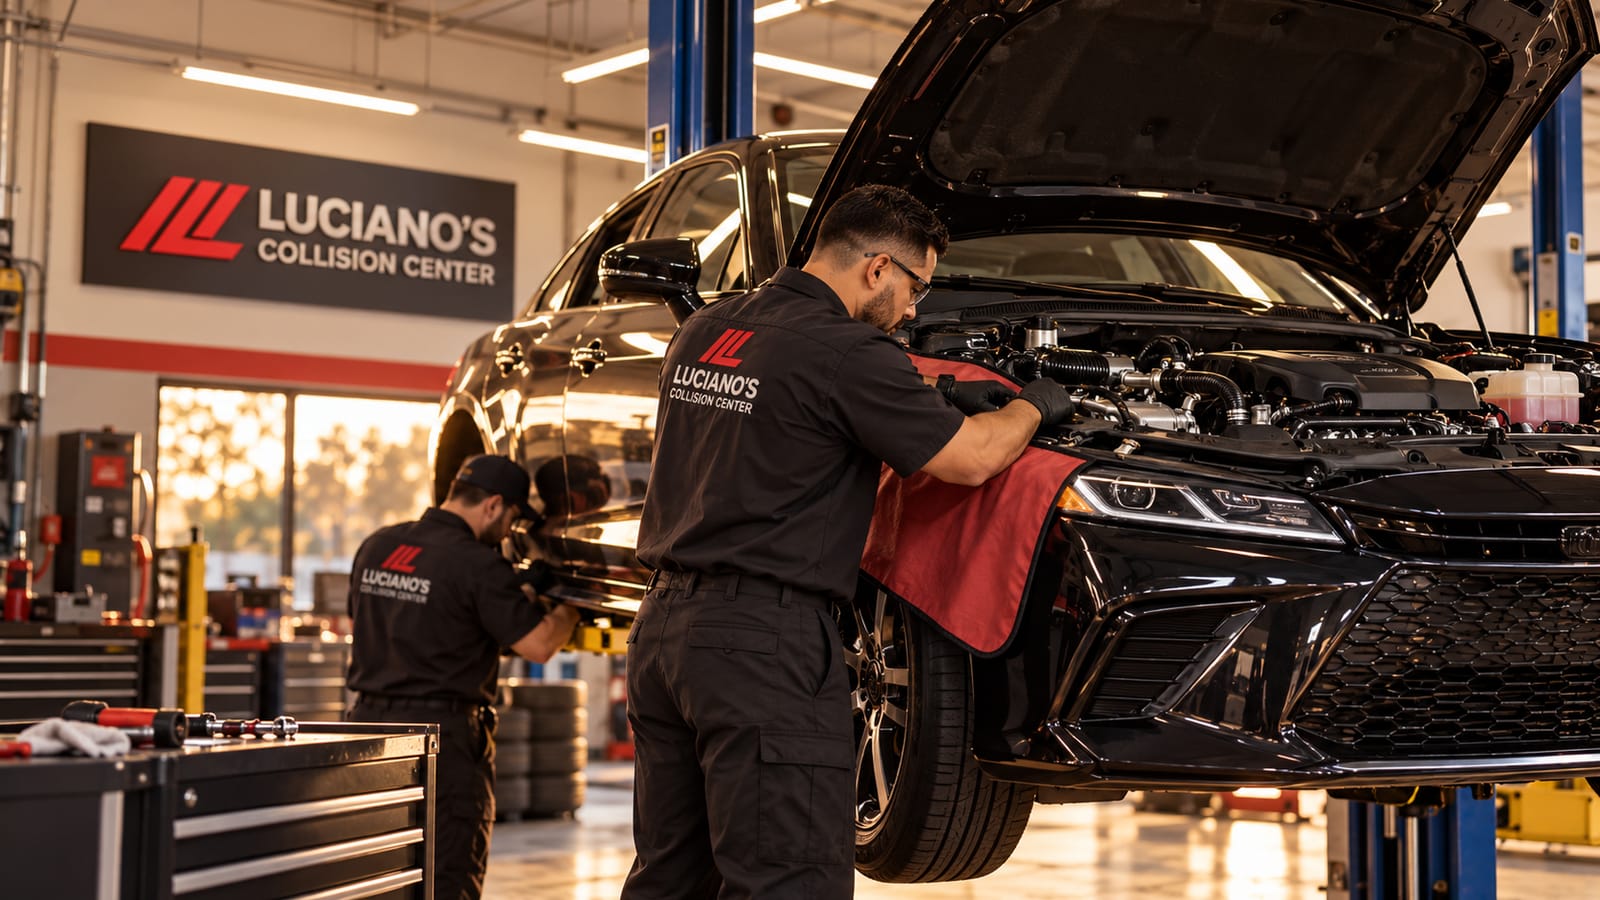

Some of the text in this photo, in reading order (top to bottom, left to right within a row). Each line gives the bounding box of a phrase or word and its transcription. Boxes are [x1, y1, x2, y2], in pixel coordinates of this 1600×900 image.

[258, 189, 497, 256] LUCIANO'S
[258, 238, 495, 285] COLLISION CENTER
[673, 365, 760, 399] LUCIANO'S
[669, 387, 753, 414] COLLISION CENTER
[362, 568, 431, 595] LUCIANO'S
